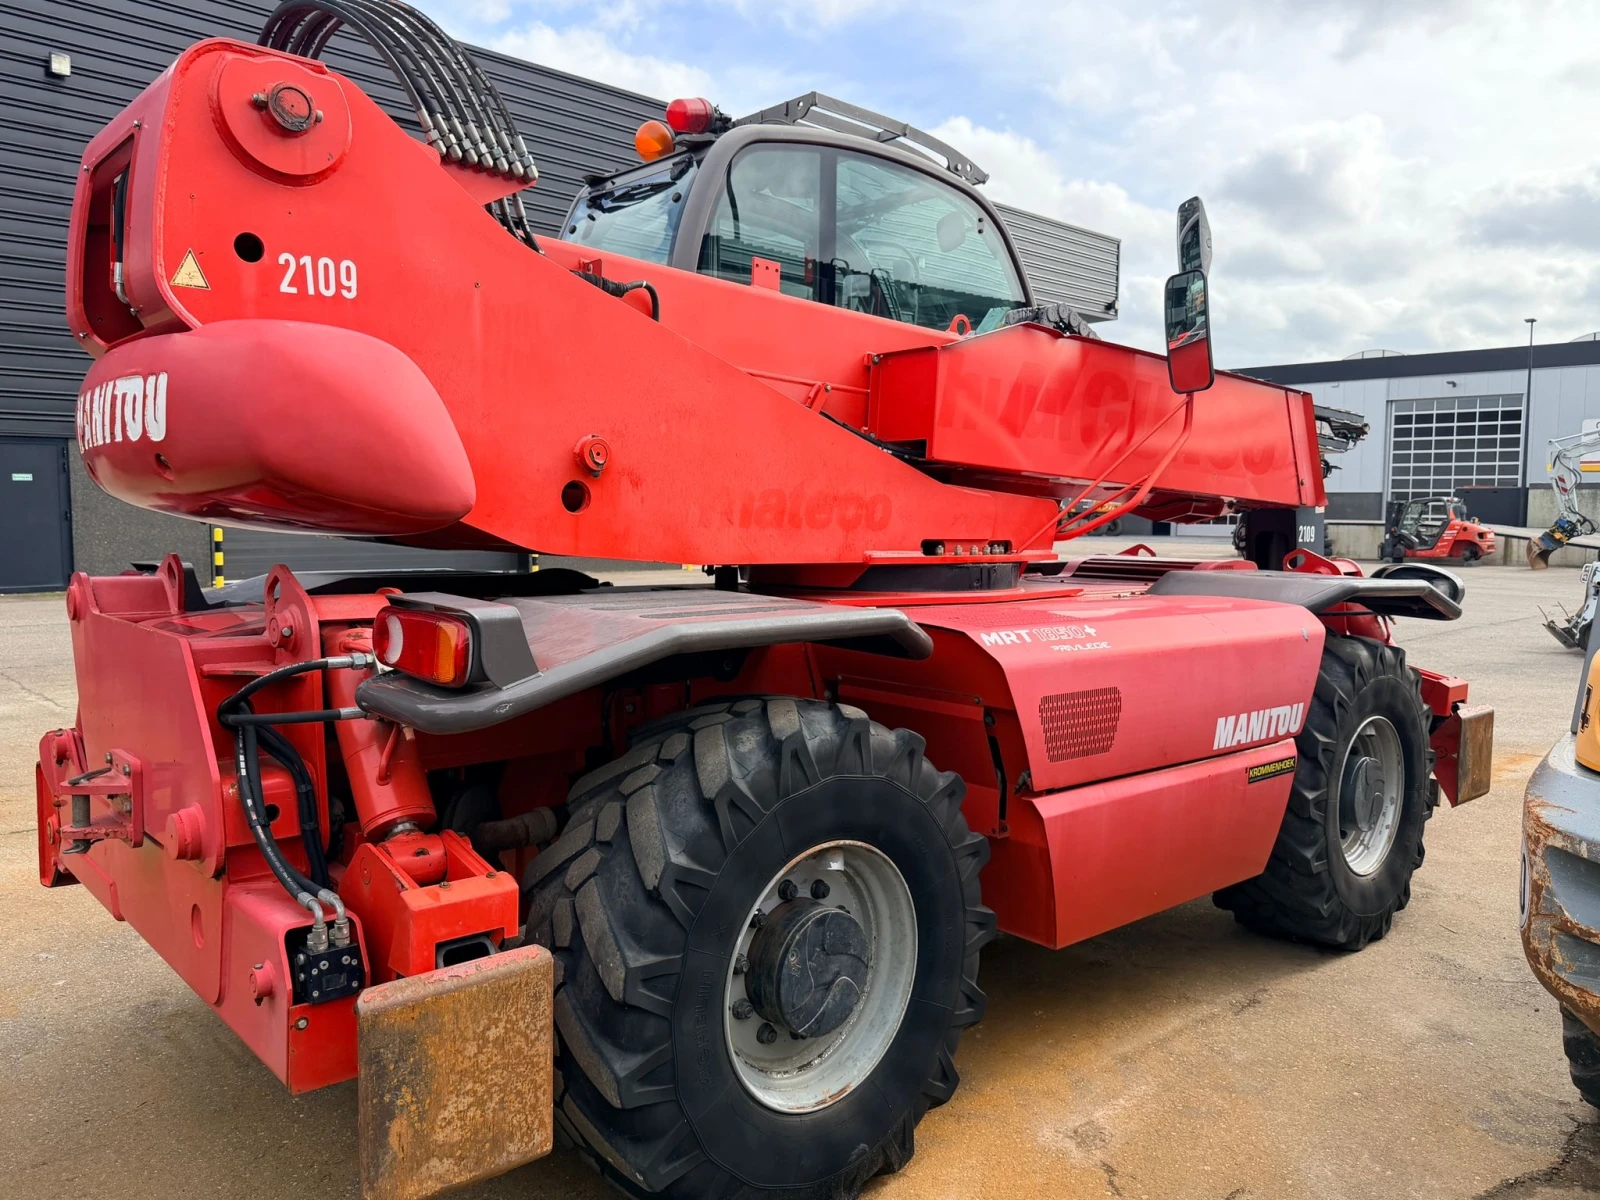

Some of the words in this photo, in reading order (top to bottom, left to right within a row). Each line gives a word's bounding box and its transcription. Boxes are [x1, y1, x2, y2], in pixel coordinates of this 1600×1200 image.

[277, 251, 358, 300] 2109
[1298, 525, 1315, 543] 2109
[979, 629, 1033, 647] MRT
[1212, 702, 1305, 751] MANITOU
[1248, 757, 1295, 779] KROMMENHOEK
